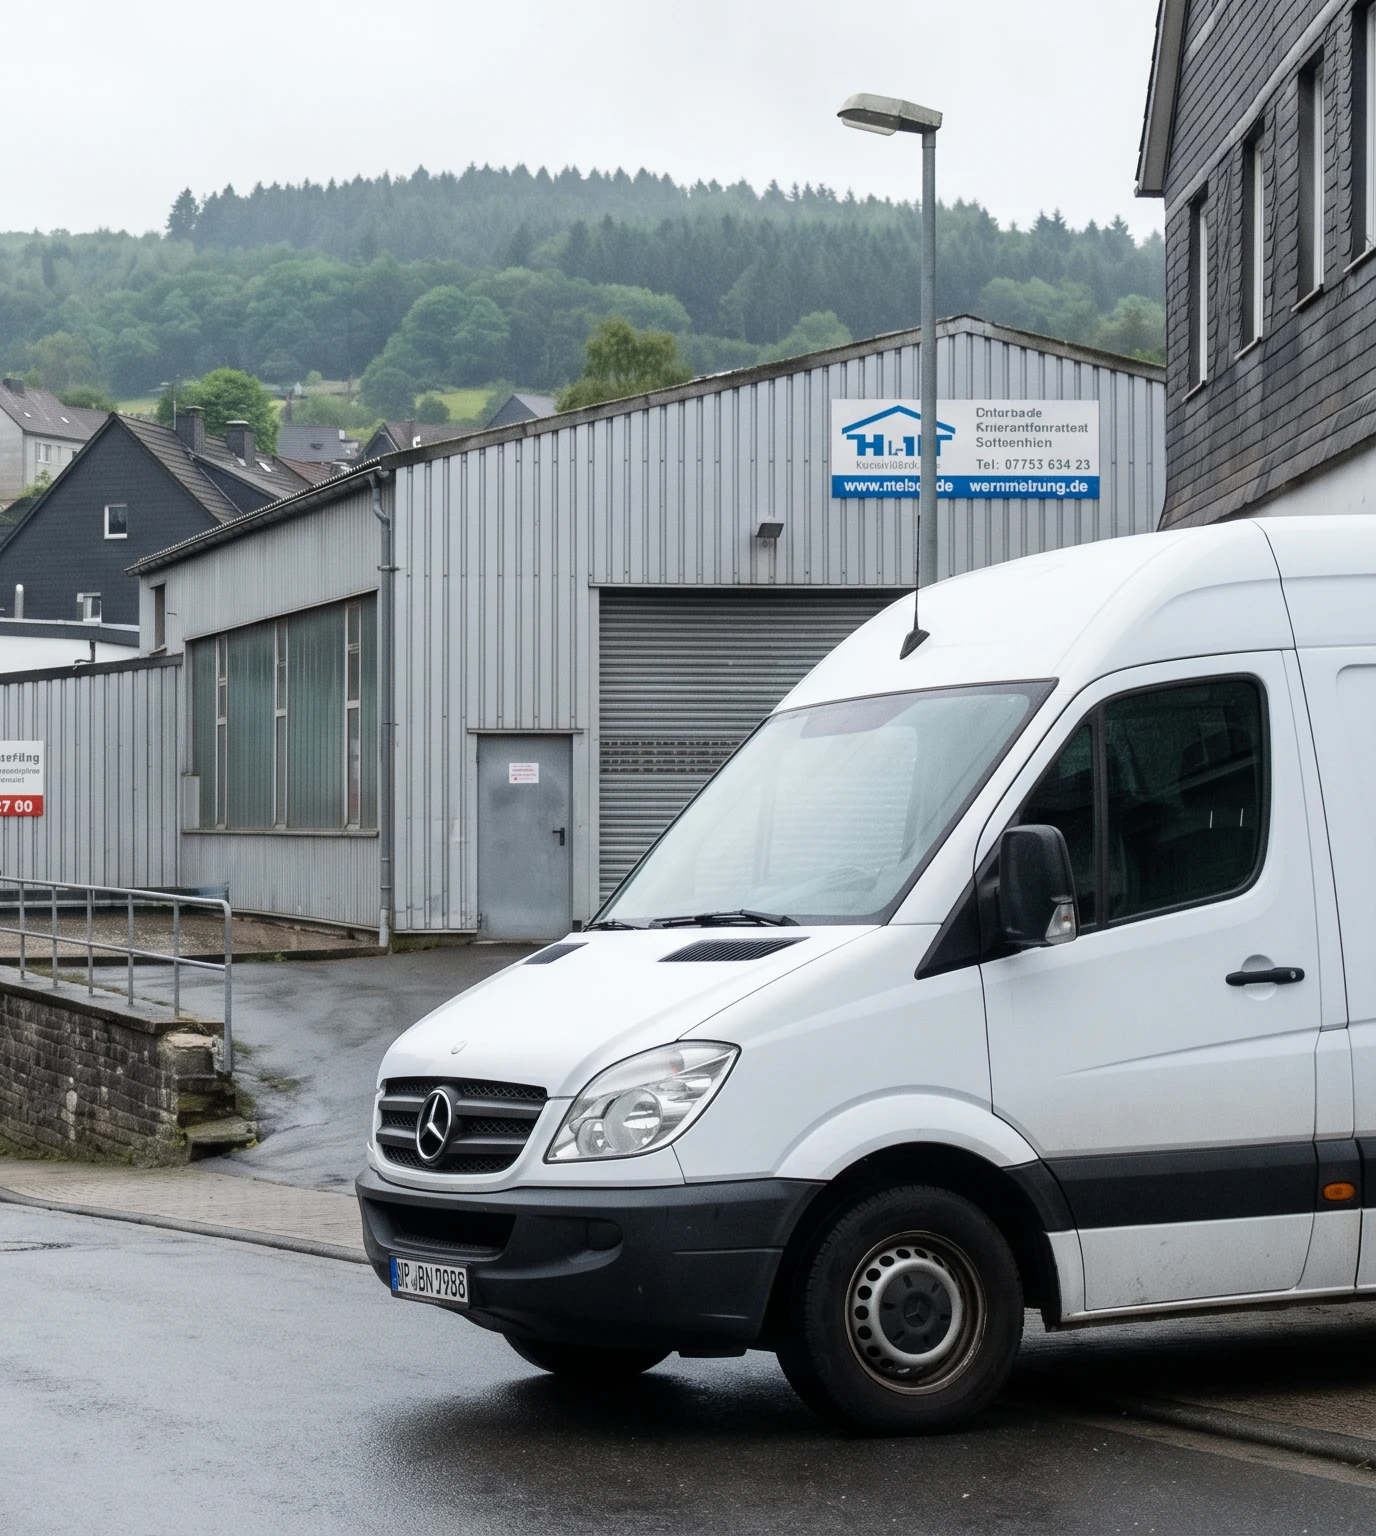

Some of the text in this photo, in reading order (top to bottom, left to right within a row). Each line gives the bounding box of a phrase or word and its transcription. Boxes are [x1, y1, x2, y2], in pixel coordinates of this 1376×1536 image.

[976, 459, 1091, 470] Tel: 07753 634 23
